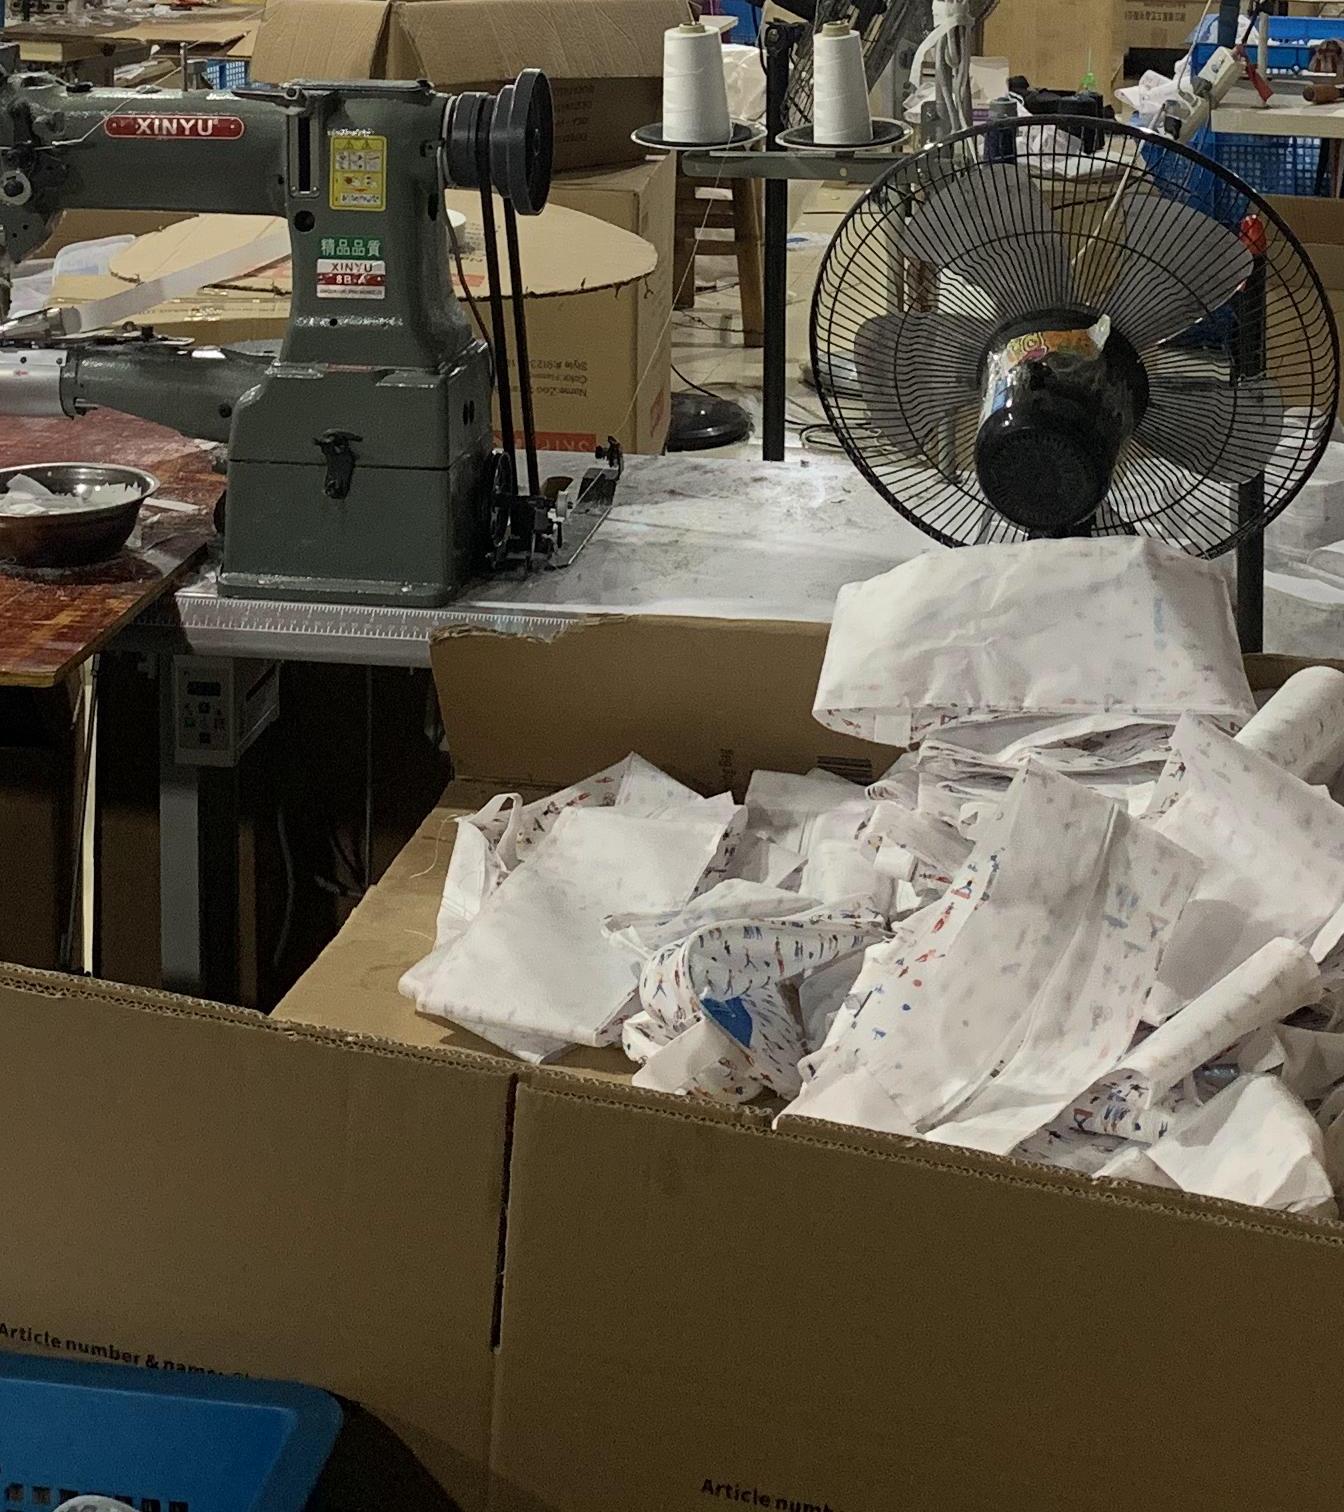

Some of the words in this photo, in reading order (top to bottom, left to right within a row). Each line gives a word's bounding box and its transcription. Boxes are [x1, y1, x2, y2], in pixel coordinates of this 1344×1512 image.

[135, 118, 213, 136] XINYU
[331, 262, 373, 273] XINYU
[65, 1338, 140, 1367] number
[701, 1478, 771, 1508] Article
